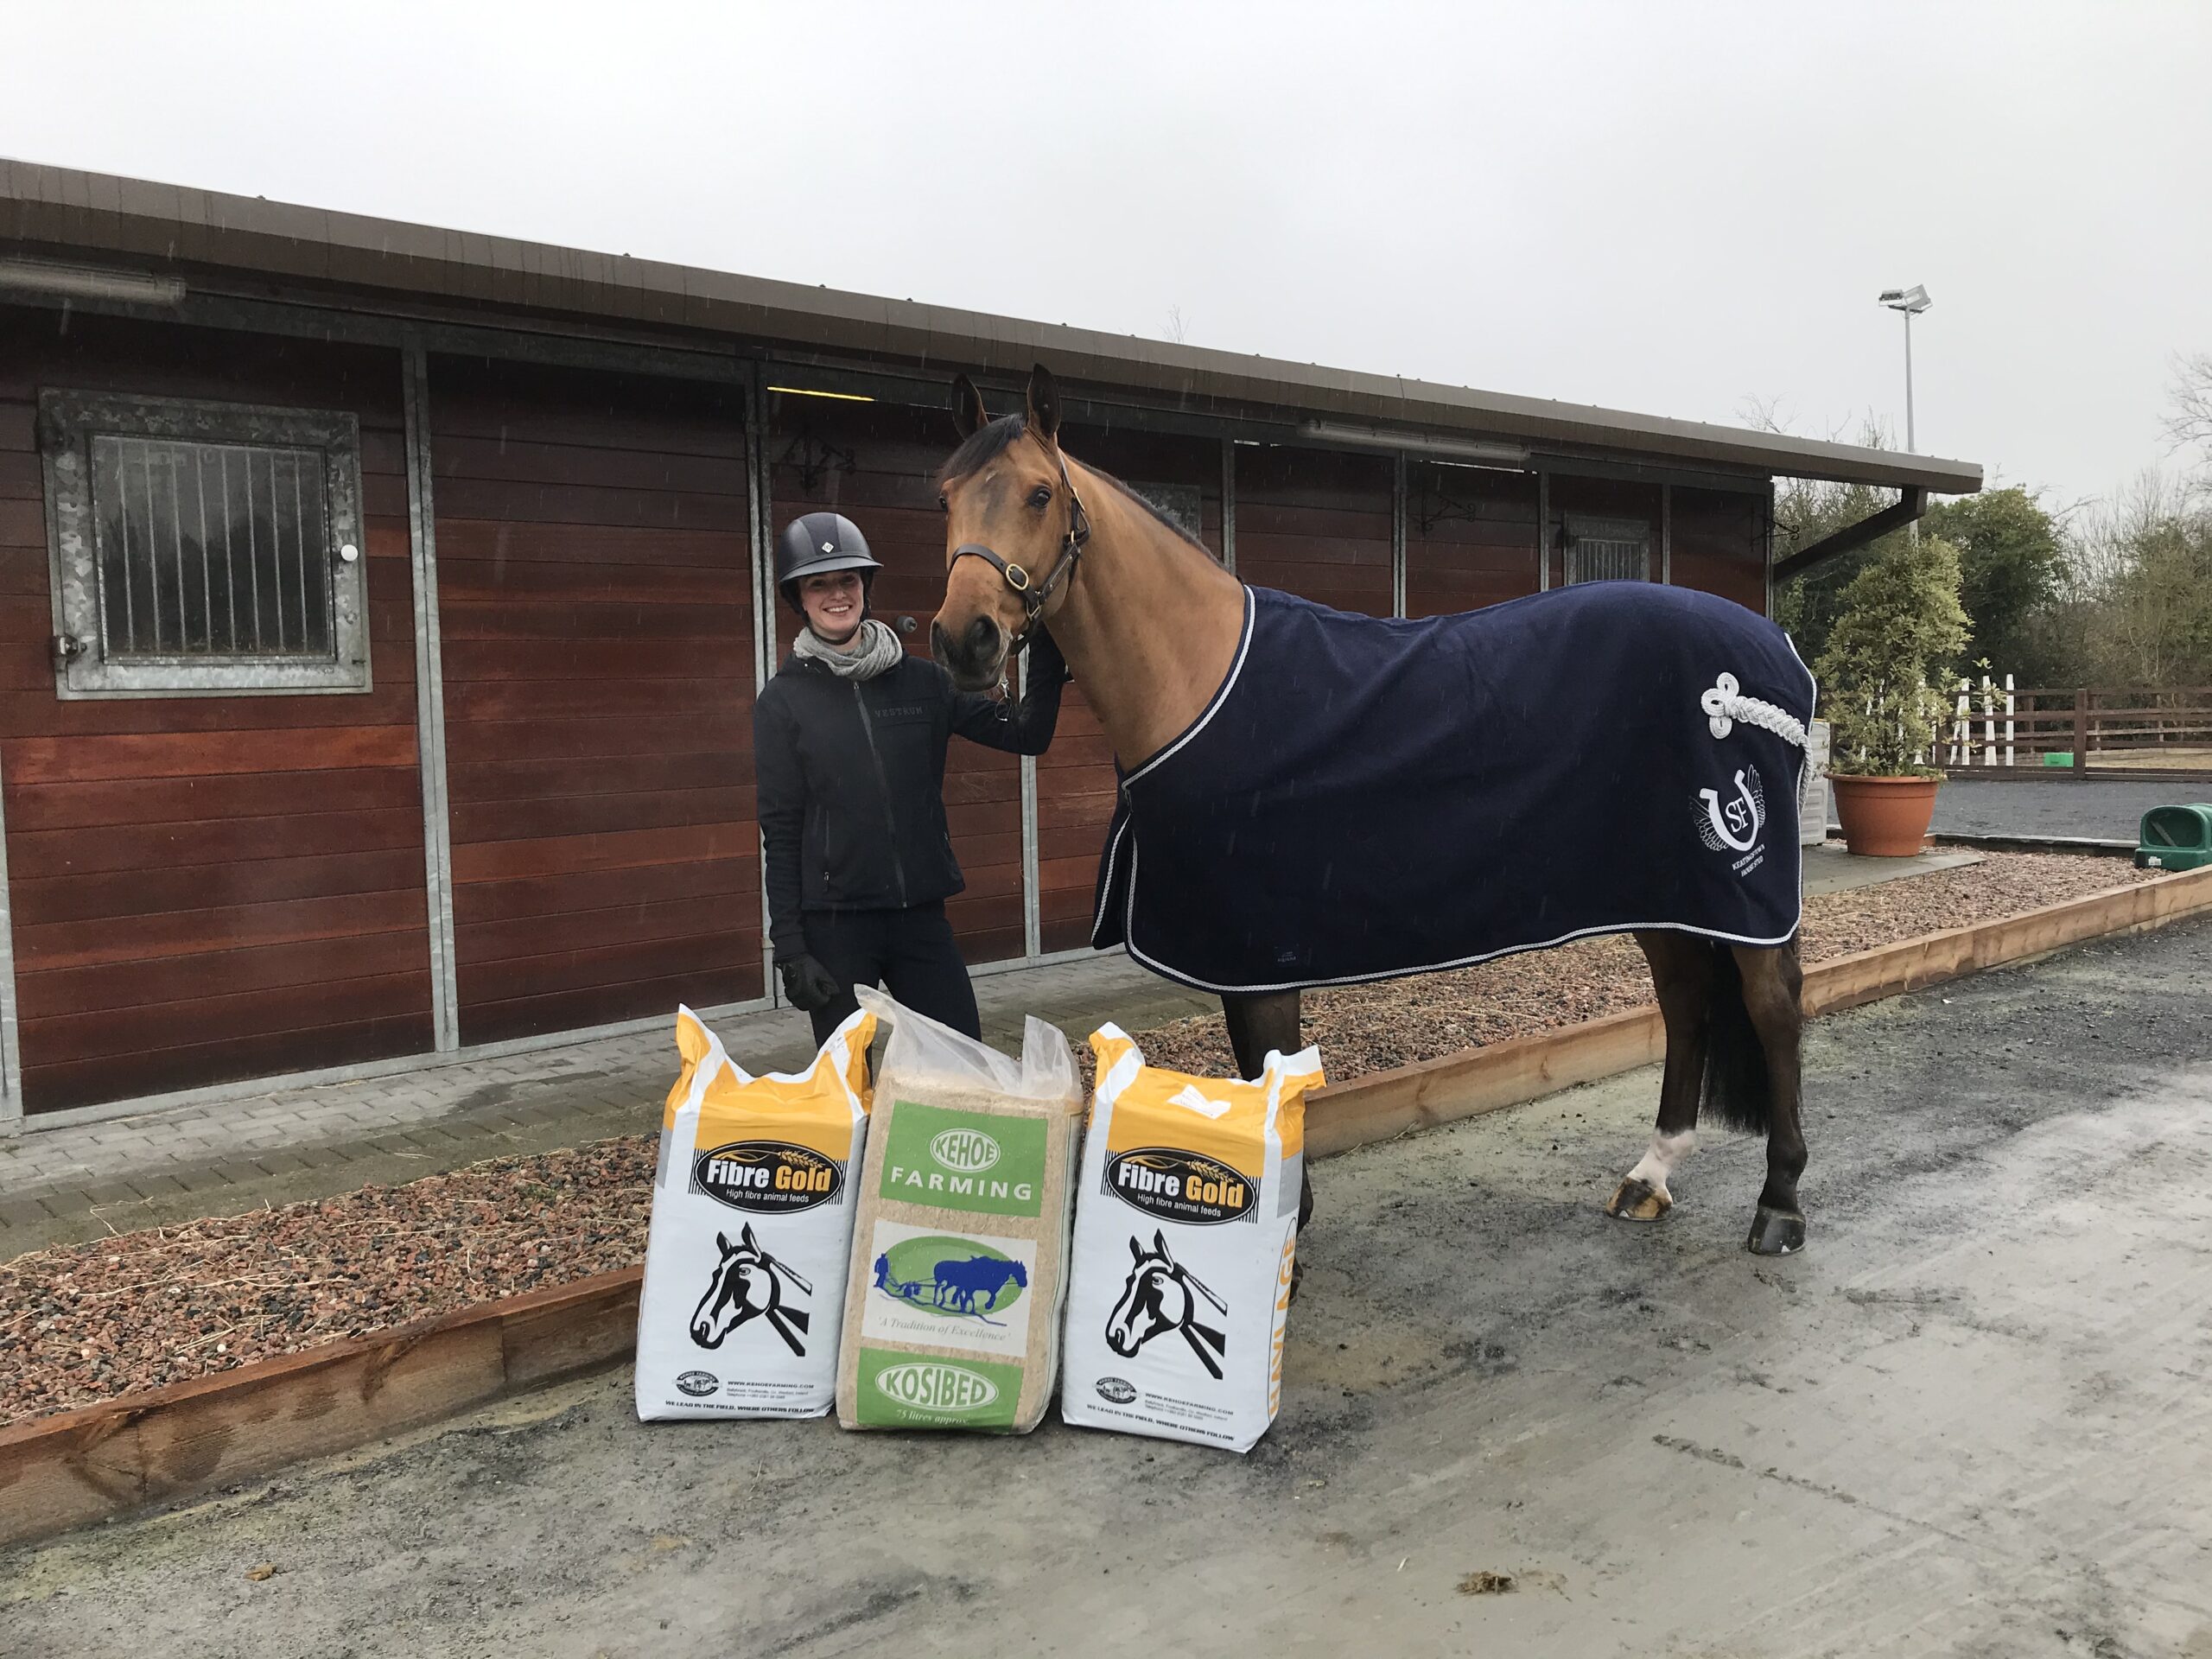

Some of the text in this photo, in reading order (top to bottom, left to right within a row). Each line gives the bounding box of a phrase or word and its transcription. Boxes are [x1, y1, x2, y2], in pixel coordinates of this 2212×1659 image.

[935, 1135, 995, 1166] KEHOE
[707, 1159, 832, 1192] Fibre Gold
[891, 1166, 1032, 1200] FARMING
[1118, 1161, 1244, 1209] Fibre Gold
[726, 1189, 810, 1203] High fibre animal feeds
[1137, 1193, 1222, 1217] High fibre animal feeds
[891, 1318, 937, 1332] Tradition
[938, 1325, 949, 1335] of
[886, 1367, 987, 1407] KOSIBED
[908, 1410, 932, 1422] litres
[1097, 1406, 1114, 1414] LEAD
[1156, 1419, 1179, 1428] WHERE
[1179, 1424, 1206, 1434] OTHERS
[1206, 1430, 1235, 1440] FOLLOW
